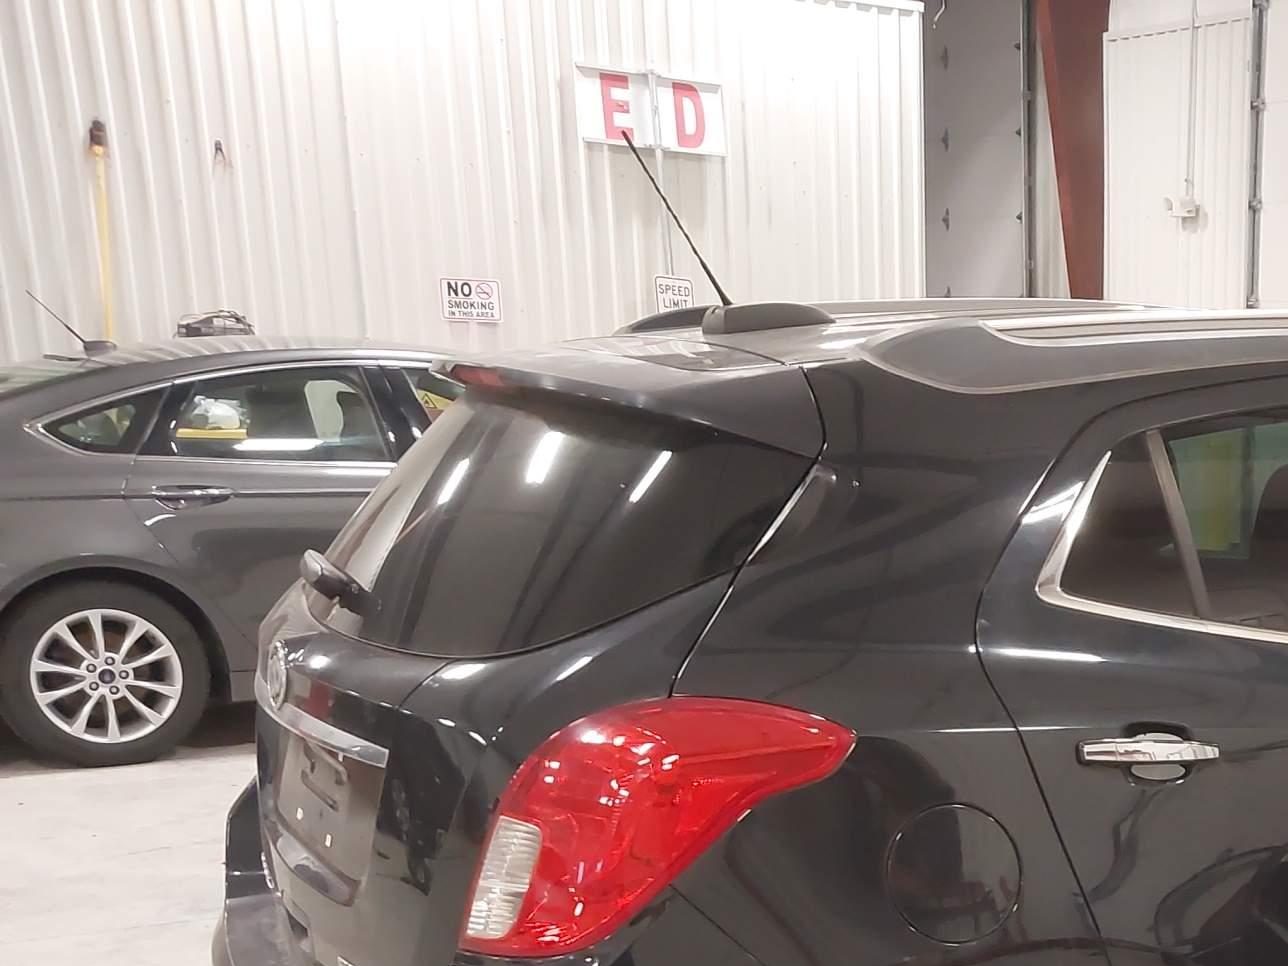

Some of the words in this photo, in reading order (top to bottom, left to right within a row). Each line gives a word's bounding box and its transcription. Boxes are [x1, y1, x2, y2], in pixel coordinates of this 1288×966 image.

[599, 72, 634, 141] E
[672, 81, 706, 149] D
[446, 281, 472, 297] NO
[658, 283, 690, 297] SPEED
[447, 299, 495, 311] SMOKING
[662, 297, 688, 309] LIMIT
